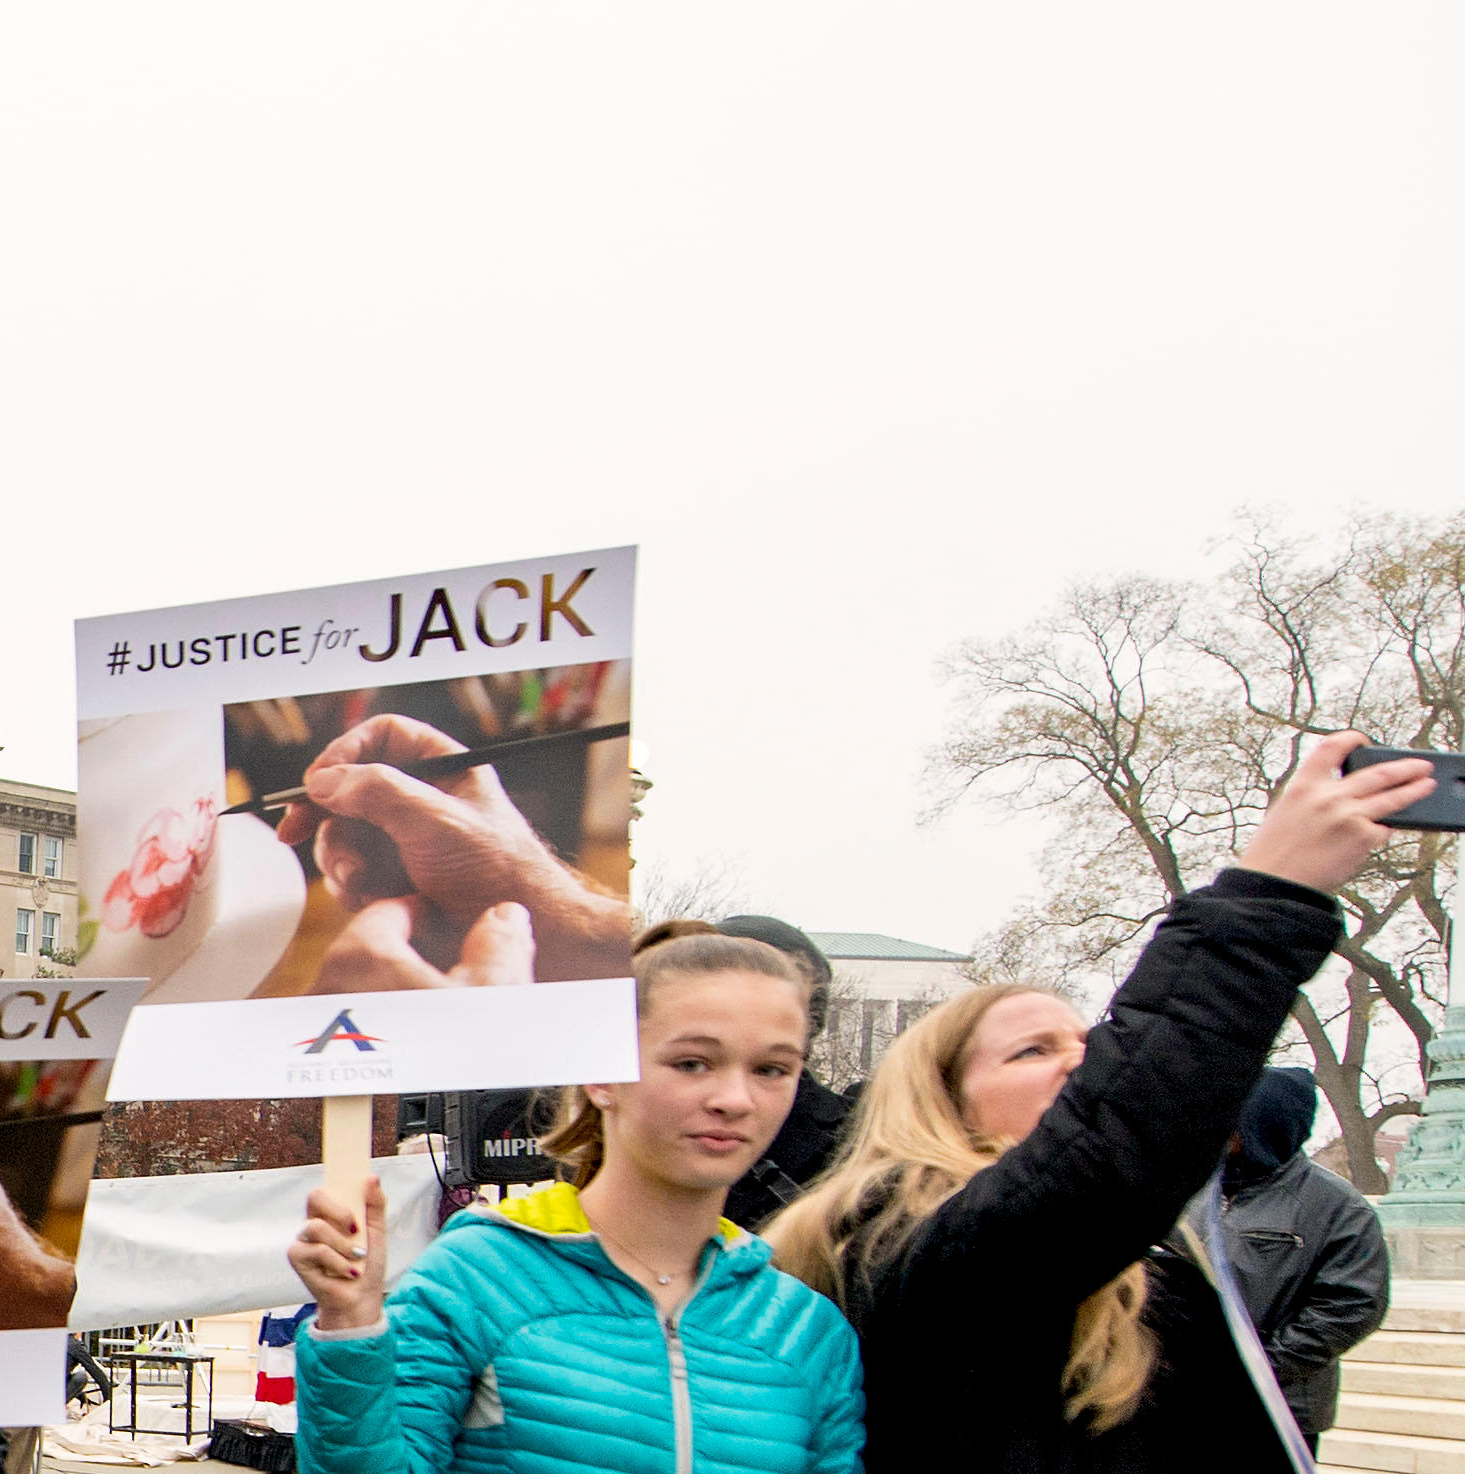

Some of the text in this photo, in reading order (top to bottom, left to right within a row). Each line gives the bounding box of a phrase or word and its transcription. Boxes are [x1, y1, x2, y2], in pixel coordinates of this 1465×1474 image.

[107, 568, 598, 677] #JUSTICE for JACK
[286, 1067, 394, 1084] FREEDOM
[484, 1128, 543, 1157] MIPR
